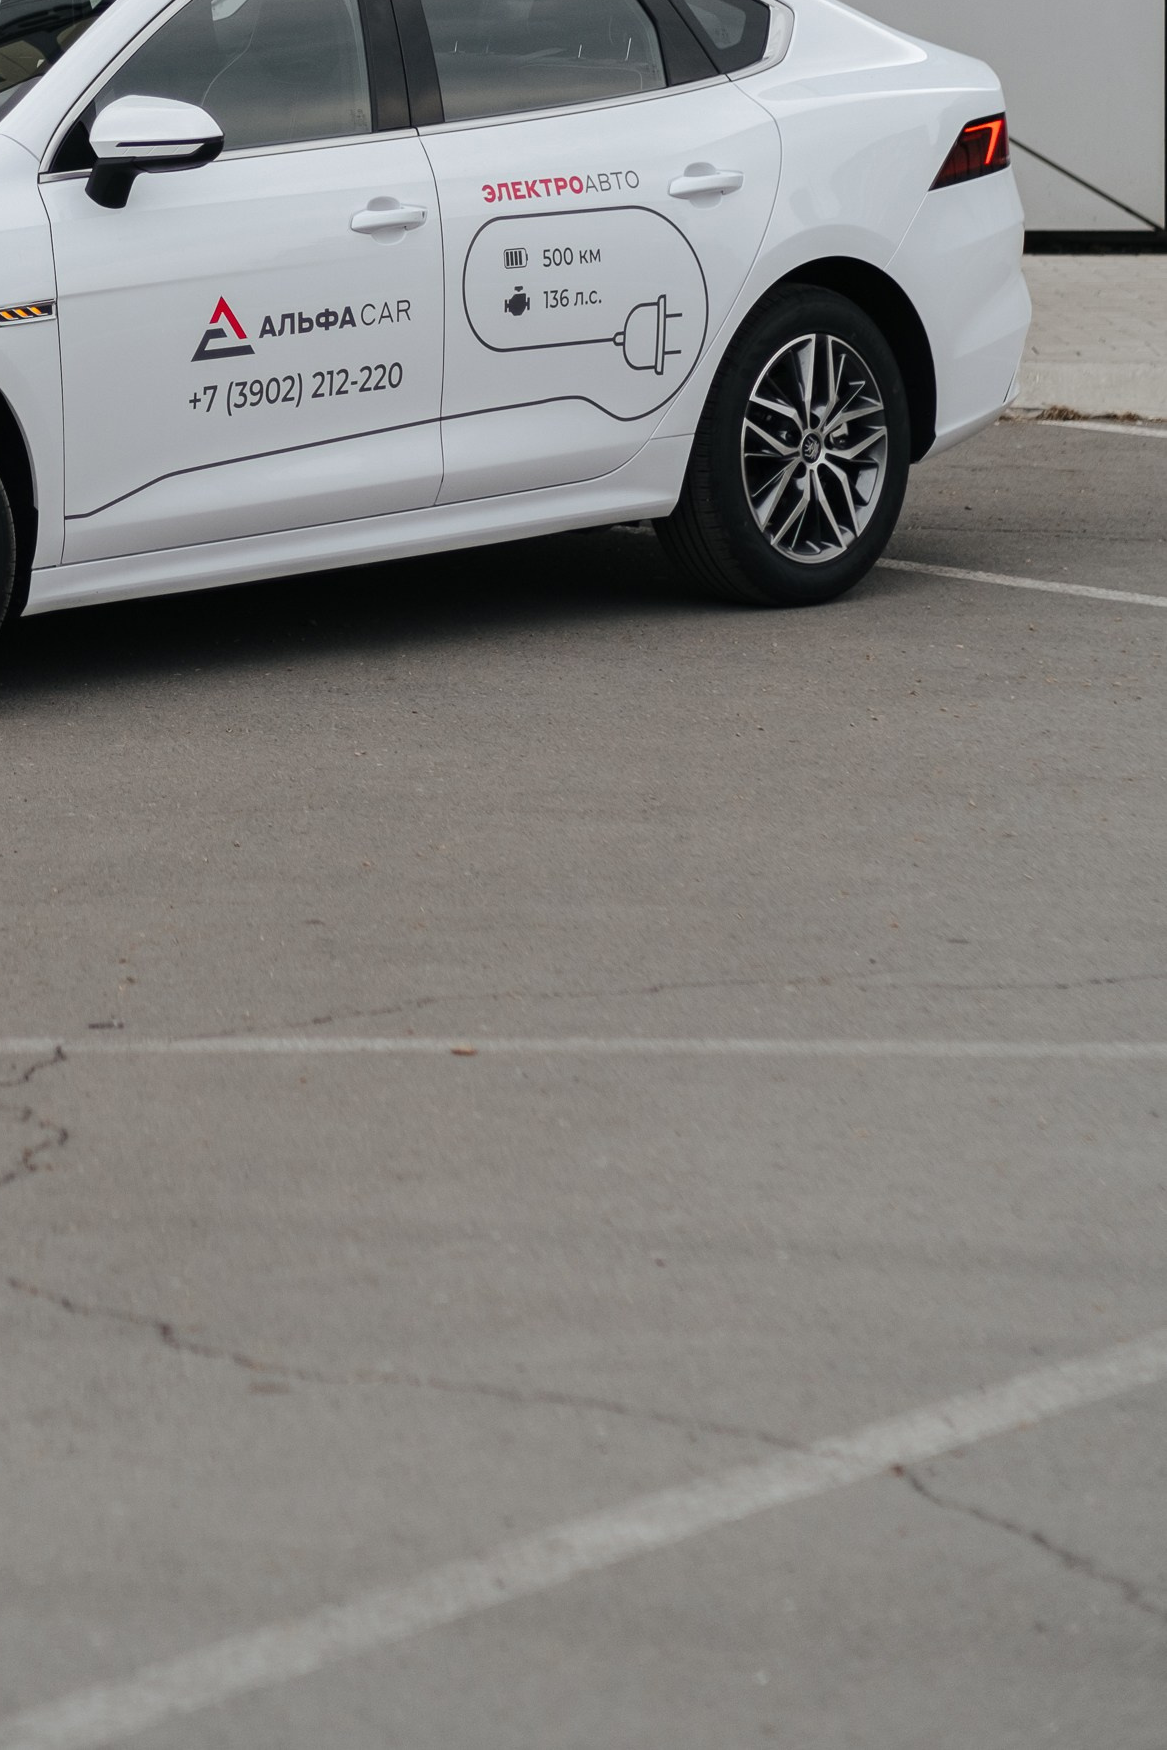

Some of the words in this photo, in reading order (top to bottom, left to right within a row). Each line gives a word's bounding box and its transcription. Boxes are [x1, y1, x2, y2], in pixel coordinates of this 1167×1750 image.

[482, 170, 640, 203] ЭЛЕКТРОАВТО
[542, 247, 574, 267] 500
[543, 288, 570, 309] 136
[188, 385, 218, 413] +7
[226, 372, 303, 417] (3902)
[311, 361, 404, 399] 212-220
